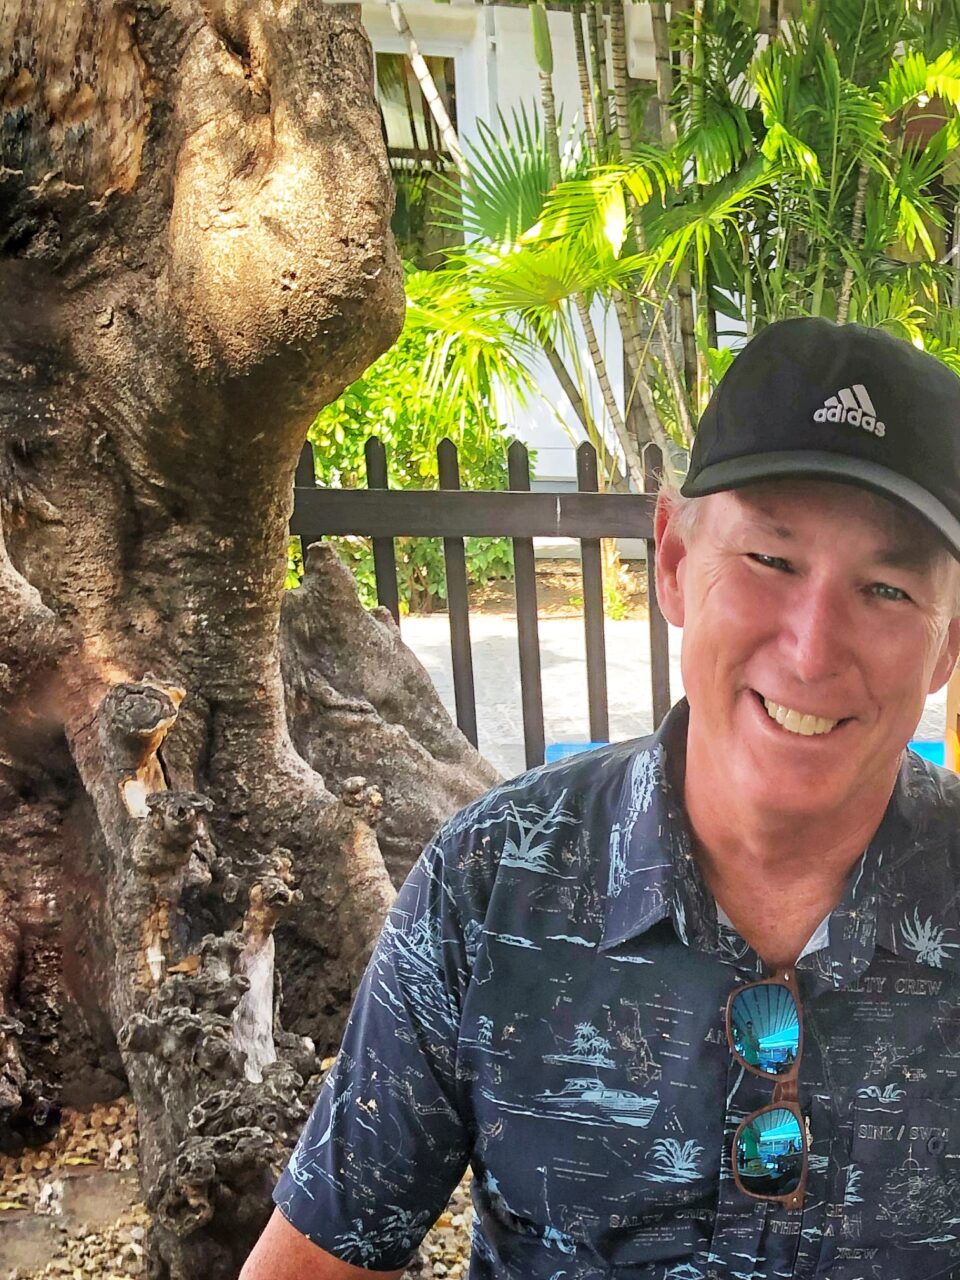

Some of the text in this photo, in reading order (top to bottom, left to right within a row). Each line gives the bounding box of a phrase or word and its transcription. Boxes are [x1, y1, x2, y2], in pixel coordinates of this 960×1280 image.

[813, 403, 885, 438] adidas
[894, 978, 943, 996] CREW
[858, 1124, 894, 1141] SINK
